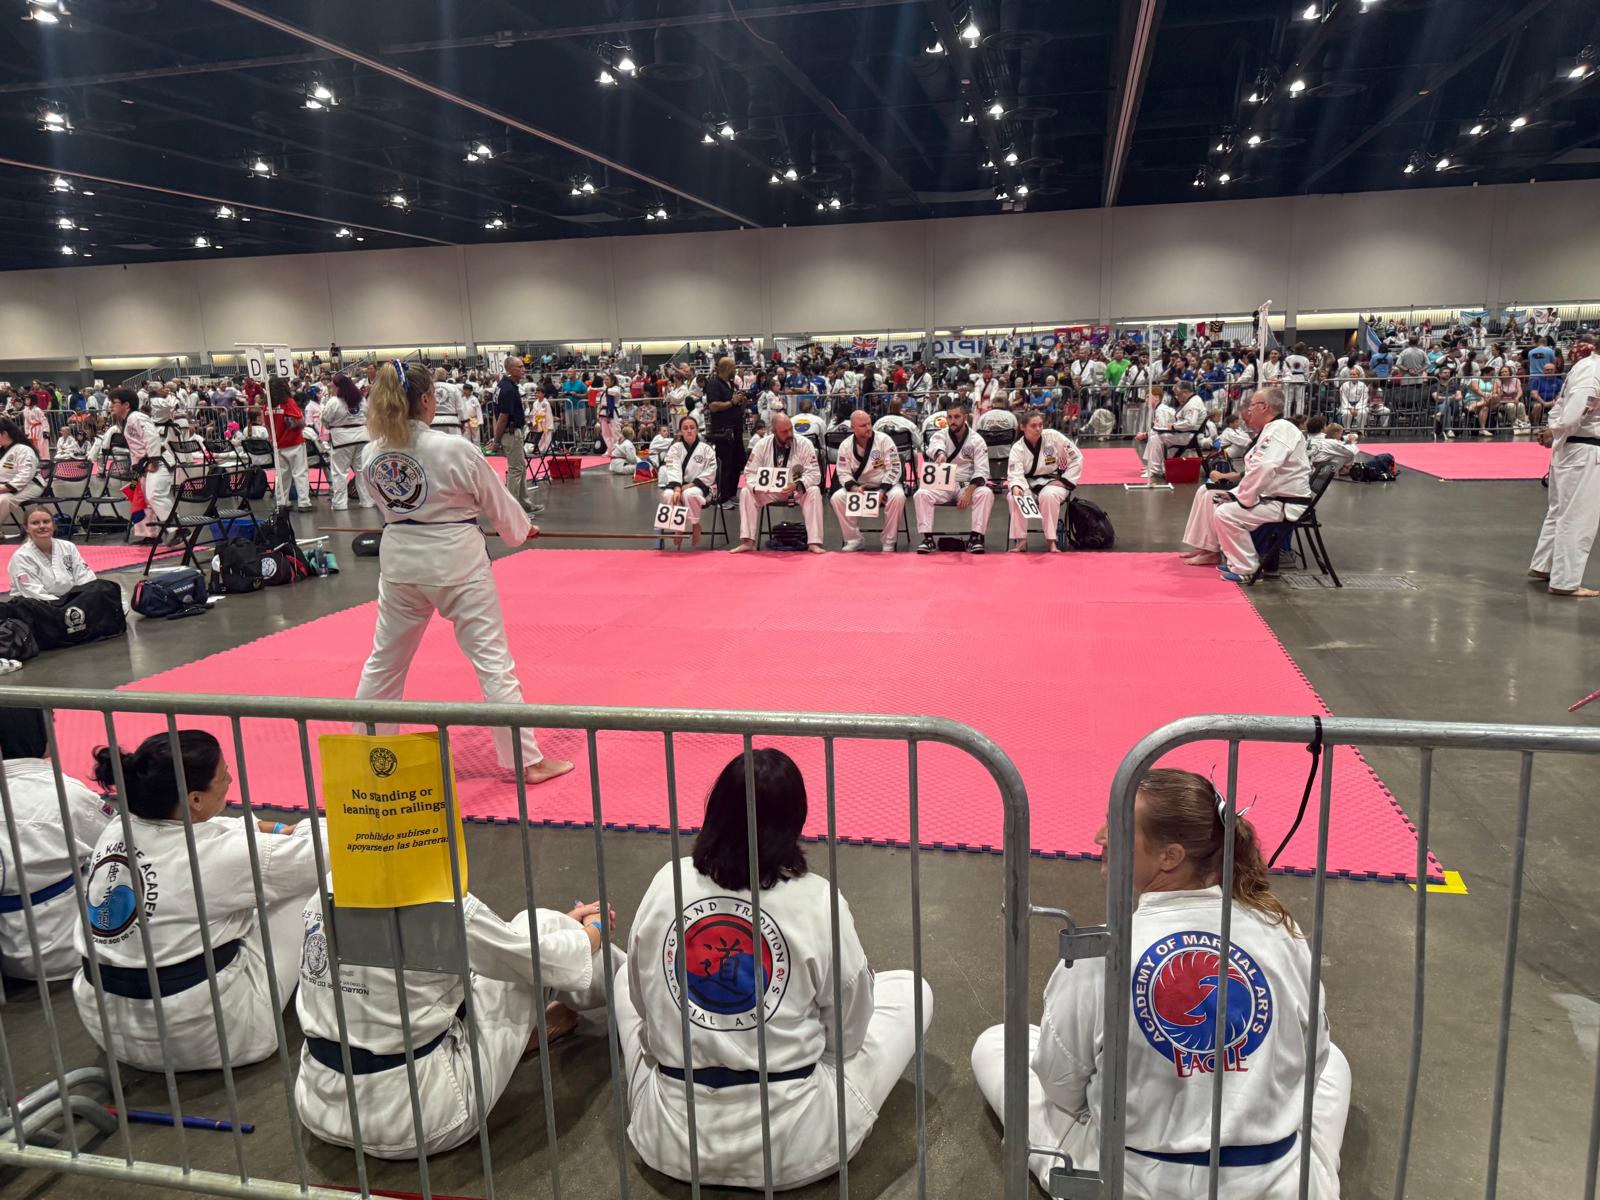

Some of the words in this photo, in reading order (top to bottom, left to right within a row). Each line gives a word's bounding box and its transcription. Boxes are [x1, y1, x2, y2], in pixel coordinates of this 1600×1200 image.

[250, 358, 261, 377] D
[279, 359, 289, 376] 5
[352, 789, 368, 800] No
[370, 788, 417, 803] standing
[419, 787, 433, 797] or
[343, 803, 381, 819] leaning
[382, 808, 397, 817] on
[400, 800, 446, 815] railings
[355, 831, 395, 842] prohibido
[396, 828, 431, 840] subirse
[432, 827, 439, 835] o
[346, 842, 386, 853] apoyarse
[396, 839, 410, 850] las
[140, 862, 159, 923] ACADEM
[669, 901, 717, 948] GAND
[734, 903, 785, 963] TRDITION
[667, 968, 716, 1026] MAIAL
[1136, 955, 1166, 1043] ACADEMY
[1155, 938, 1177, 956] OF
[1252, 986, 1269, 1034] ARTS
